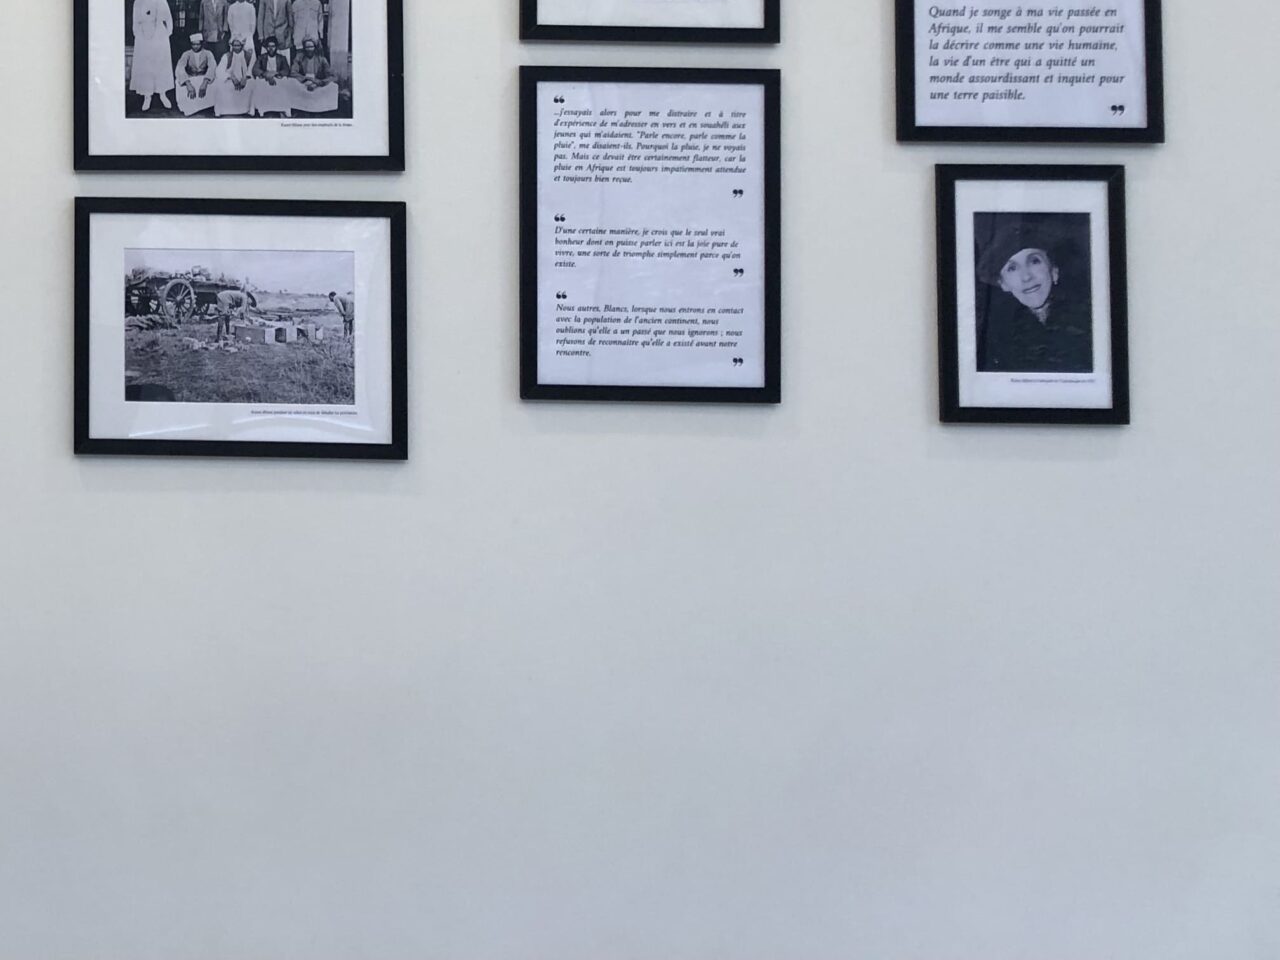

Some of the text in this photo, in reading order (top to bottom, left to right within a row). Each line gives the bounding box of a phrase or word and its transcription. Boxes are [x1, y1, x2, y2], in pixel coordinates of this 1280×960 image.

[929, 5, 1117, 20] Quand je songe à ma vie passée en
[976, 22, 984, 34] il
[987, 25, 1003, 34] me
[1006, 22, 1042, 34] semble
[1046, 22, 1075, 36] qu'on
[1079, 22, 1124, 36] pourrait
[929, 39, 939, 50] la
[943, 39, 980, 50] décrire
[983, 42, 1020, 50] comme
[1024, 42, 1045, 50] une
[1049, 39, 1064, 50] vie
[929, 55, 1095, 70] la vie d'un être qui a quitté un
[930, 72, 1125, 86] monde assourdissant et inquiet pour
[930, 92, 950, 100] une
[954, 91, 979, 100] terre
